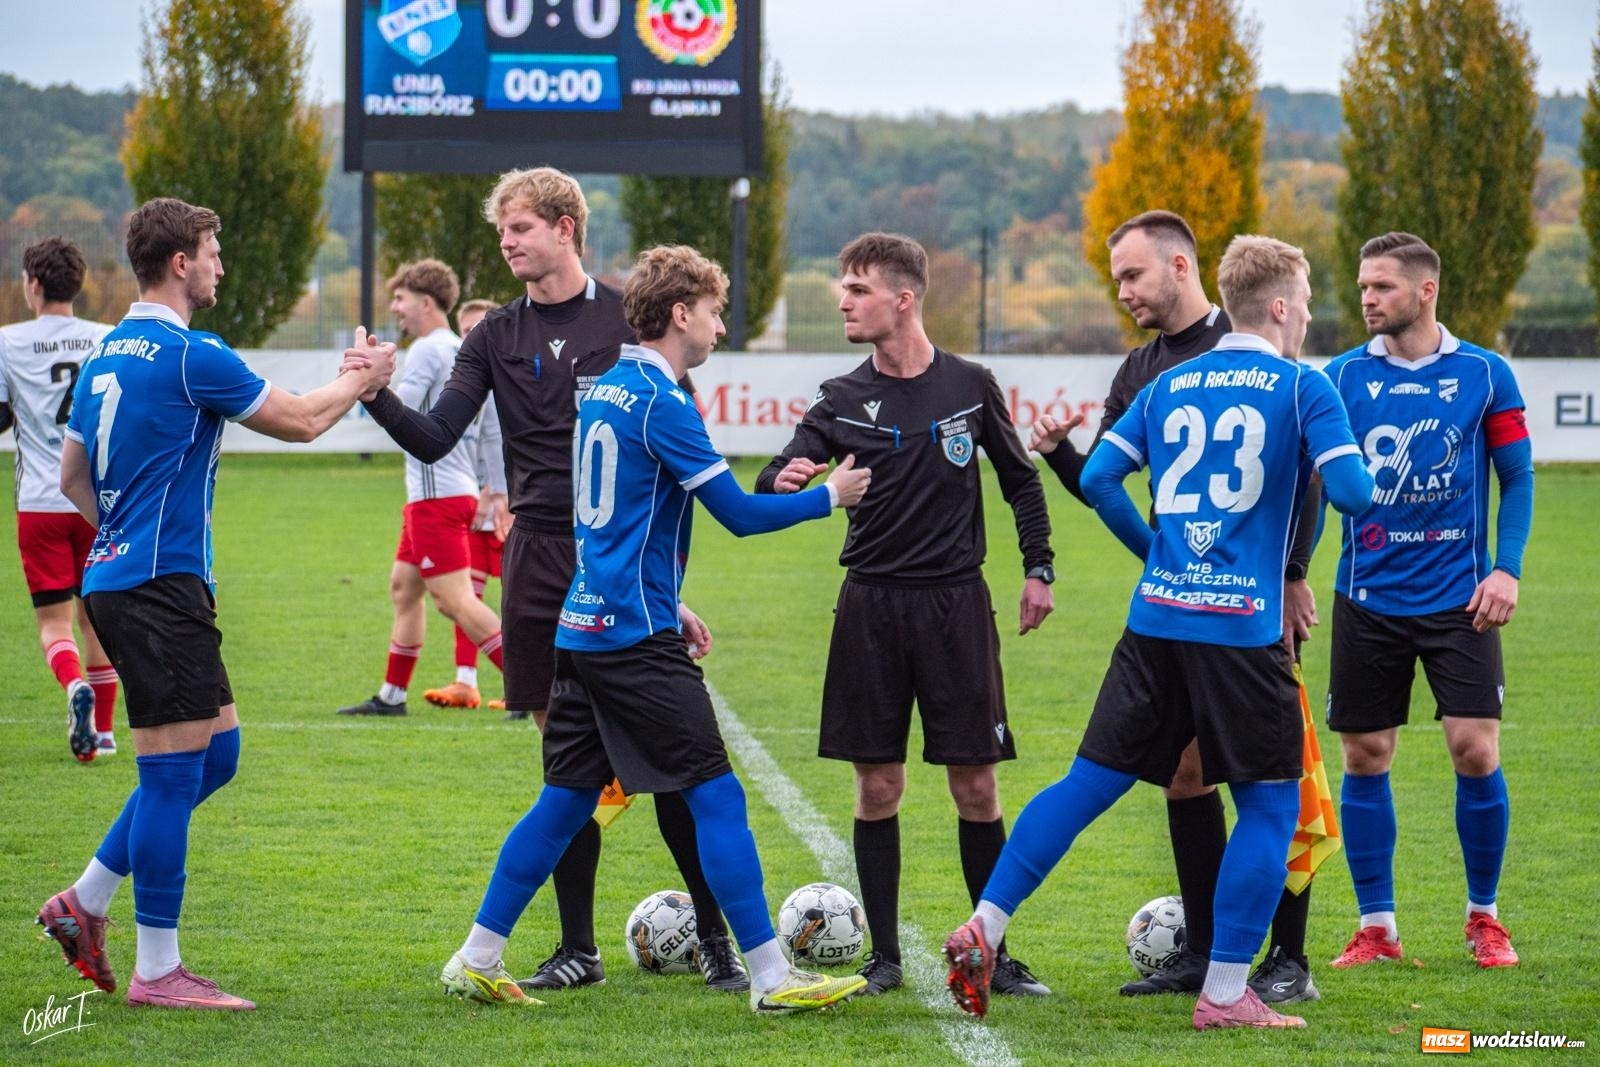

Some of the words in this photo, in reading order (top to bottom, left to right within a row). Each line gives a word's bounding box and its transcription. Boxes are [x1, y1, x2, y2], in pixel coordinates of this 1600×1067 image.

[392, 73, 445, 94] UNIA
[504, 68, 603, 102] 00:00
[364, 92, 475, 116] RACIBÓRZ
[34, 342, 59, 354] UNIA
[61, 339, 94, 352] TURZA
[103, 335, 161, 362] RACIBÓRZ
[1170, 372, 1202, 393] UNIA
[1204, 367, 1280, 392] RACIBÓRZ
[91, 371, 123, 481] 7
[1155, 404, 1266, 514] 23
[572, 418, 619, 530] 10
[1413, 472, 1453, 491] LAT
[1402, 488, 1462, 504] TRADYCJI
[1388, 531, 1424, 543] TOKAI
[1186, 561, 1213, 574] MB
[1134, 949, 1163, 970] SELE
